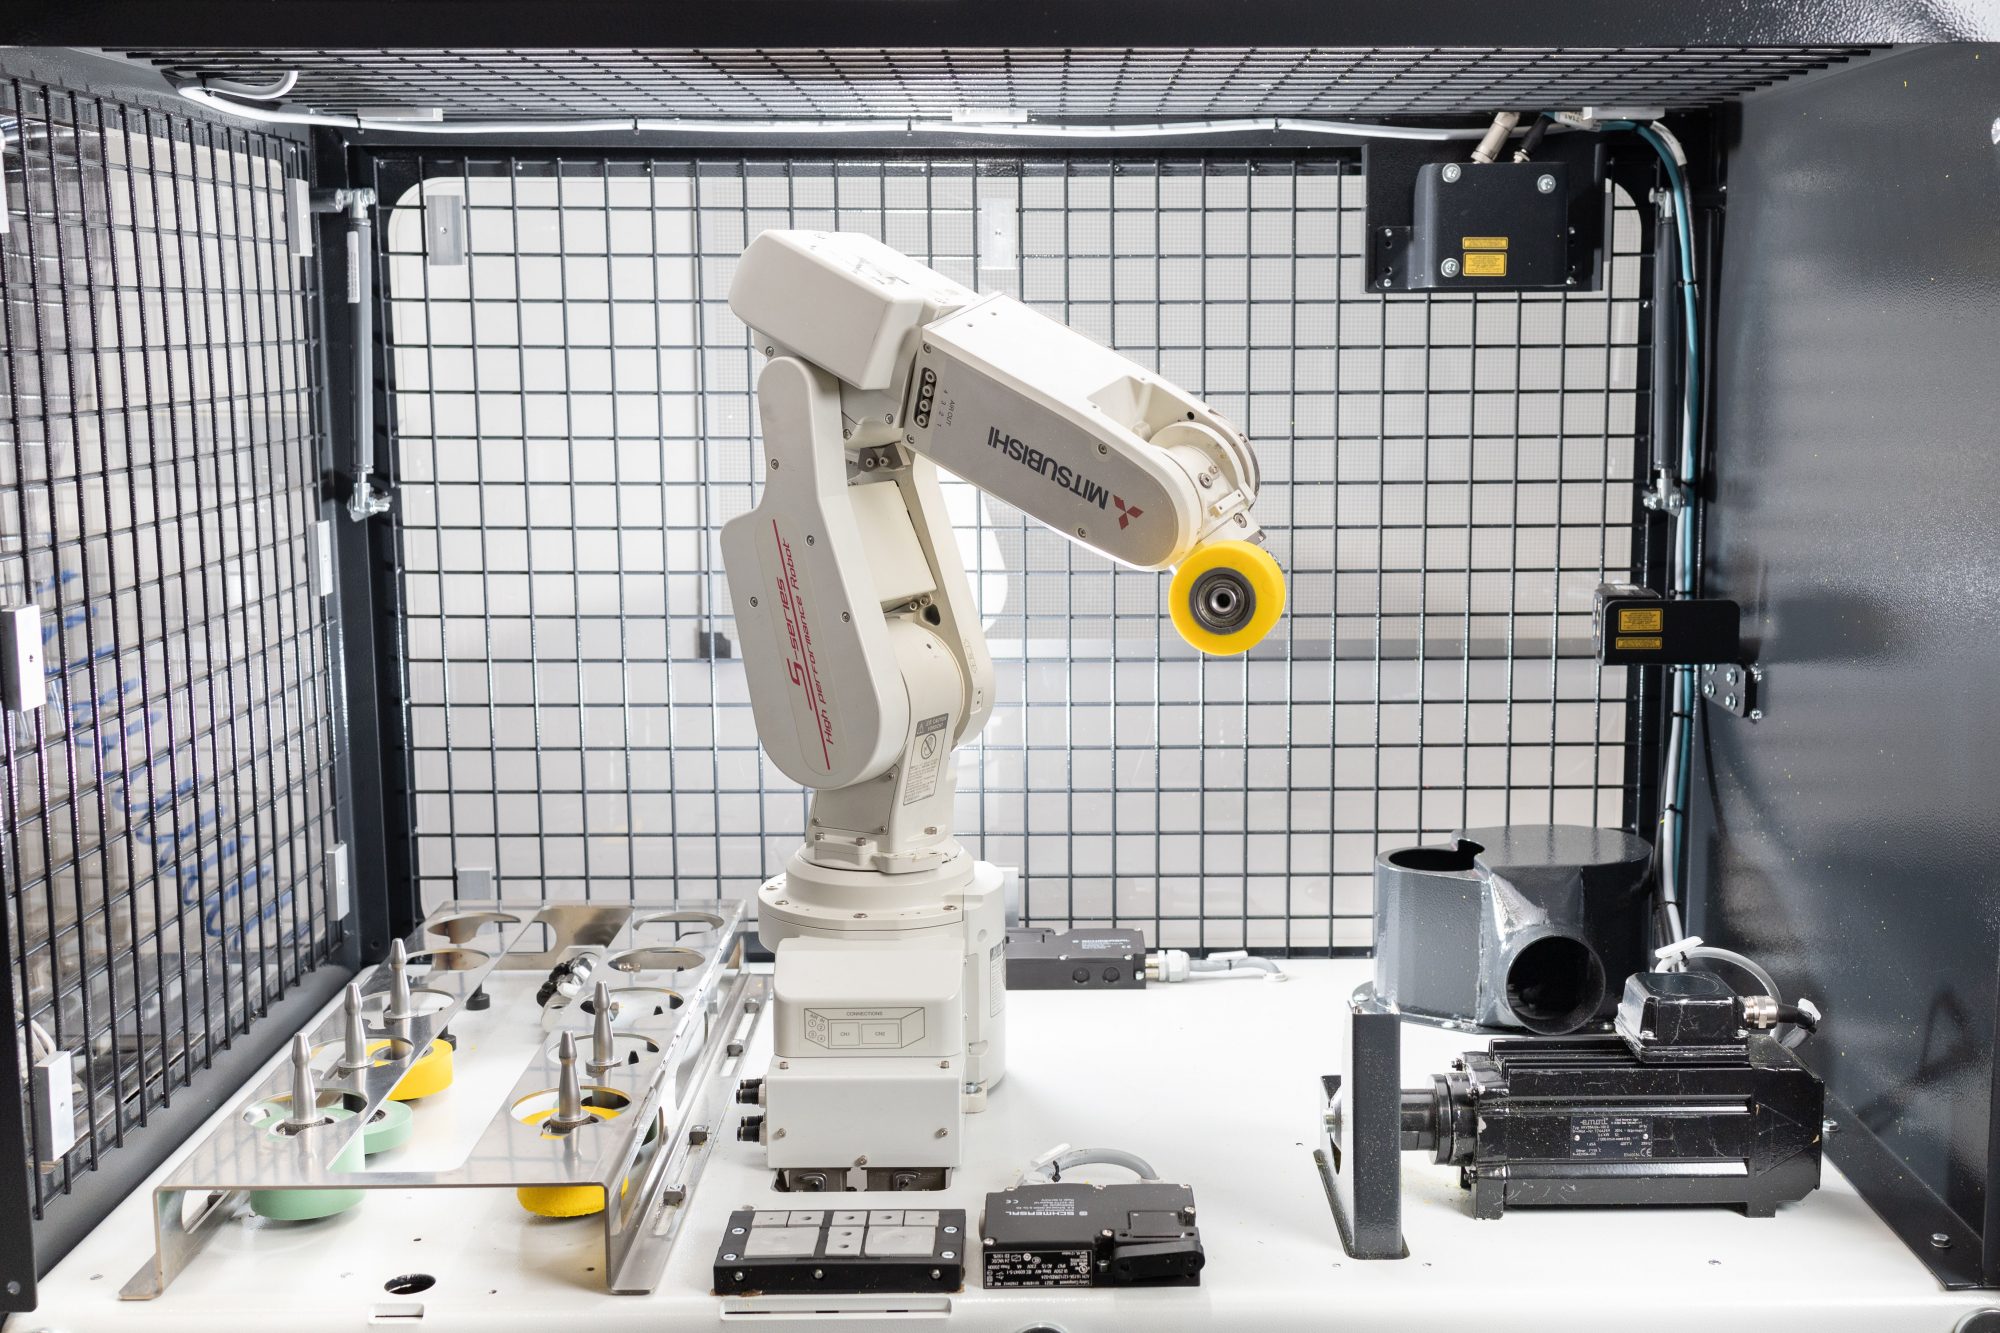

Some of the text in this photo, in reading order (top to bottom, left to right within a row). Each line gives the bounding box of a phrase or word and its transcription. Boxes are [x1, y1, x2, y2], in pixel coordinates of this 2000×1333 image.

[987, 426, 1110, 510] MITSUBISHI
[776, 576, 804, 686] S-series
[782, 537, 834, 745] High performance Robot
